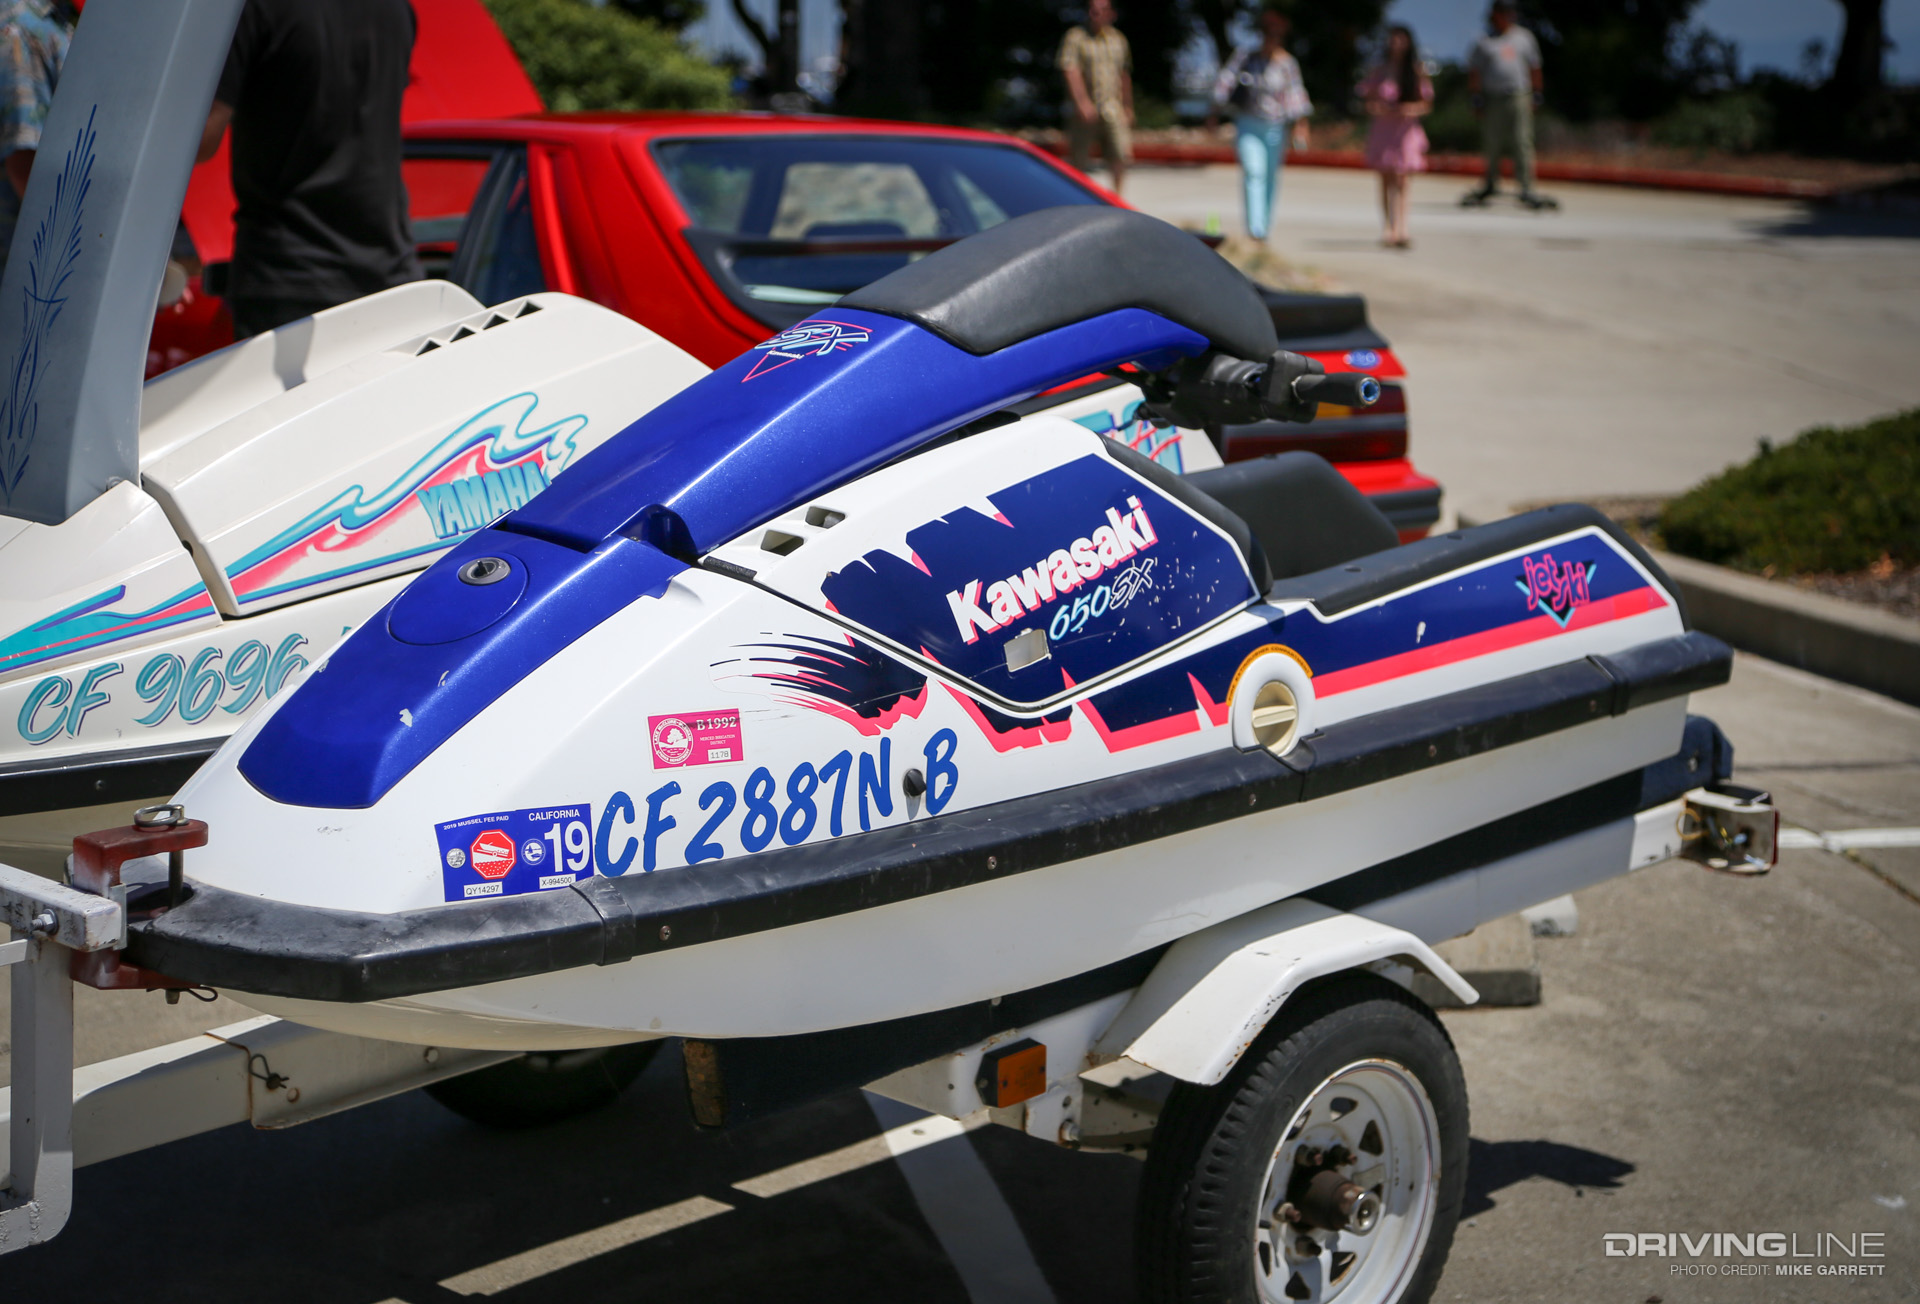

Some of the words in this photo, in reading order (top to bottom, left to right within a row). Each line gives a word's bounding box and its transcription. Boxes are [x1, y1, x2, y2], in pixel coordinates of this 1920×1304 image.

[754, 323, 869, 356] SX
[415, 461, 550, 540] YAMAHA
[946, 495, 1158, 644] Kawasaki
[17, 662, 124, 745] CF
[132, 632, 310, 727] 9696
[457, 818, 483, 828] MUSSEL
[528, 809, 580, 822] CALIFORNIA
[544, 820, 590, 873] 19
[465, 884, 500, 896] QY14297
[541, 876, 572, 886] X-994500
